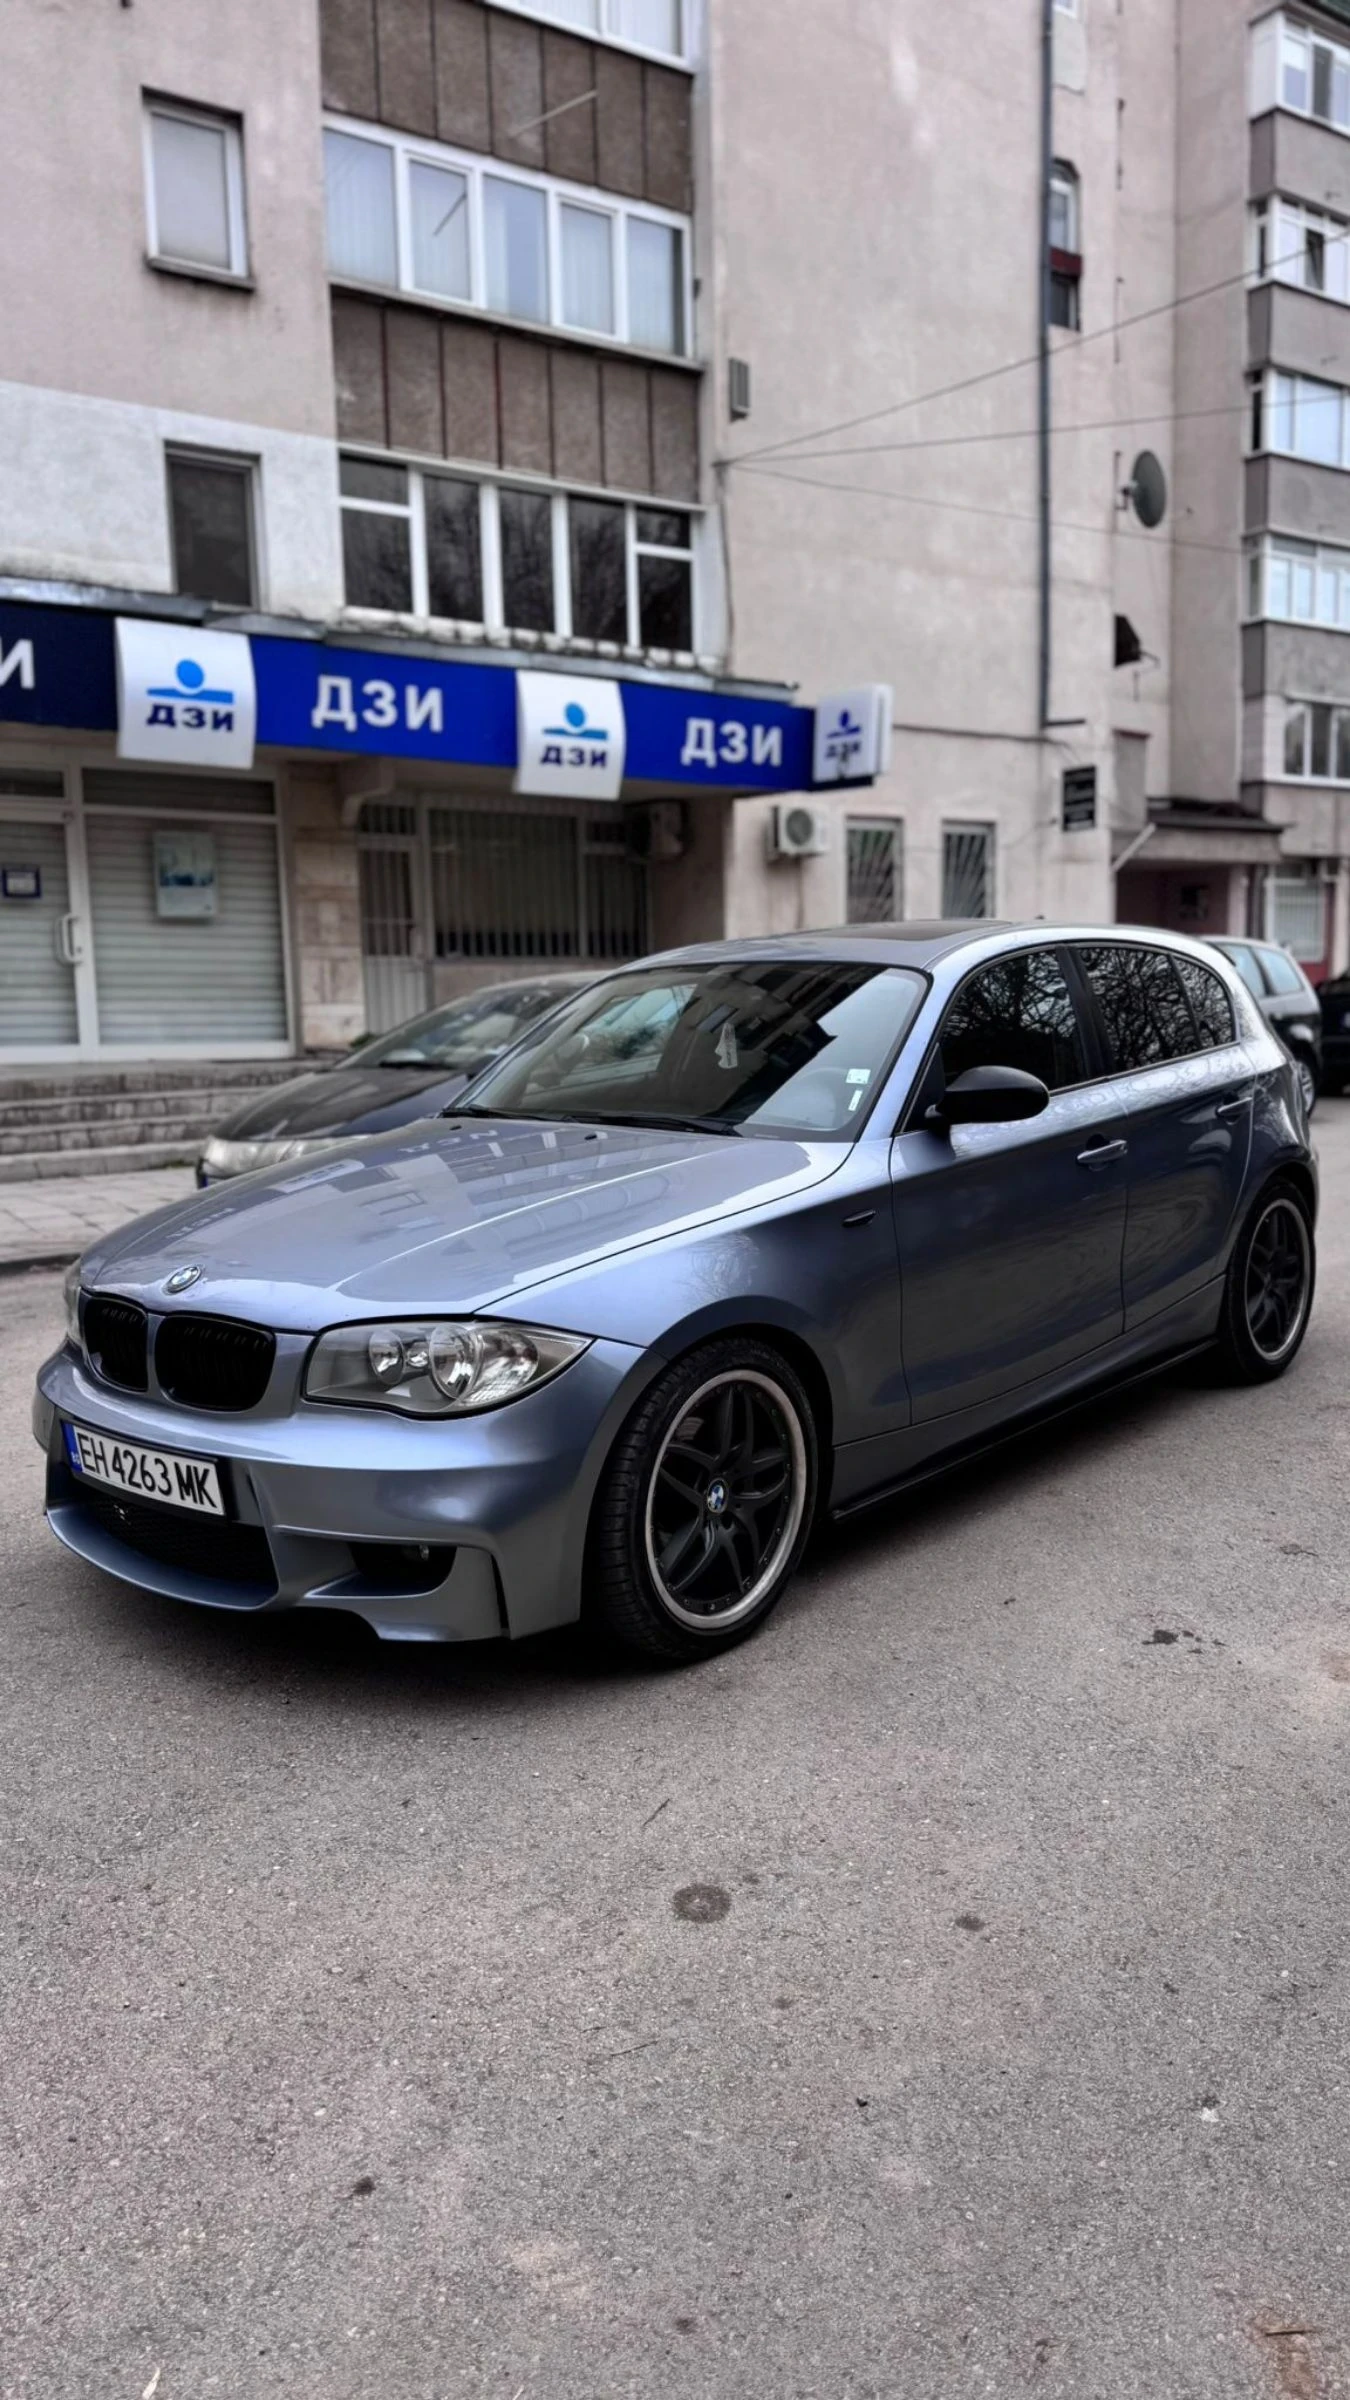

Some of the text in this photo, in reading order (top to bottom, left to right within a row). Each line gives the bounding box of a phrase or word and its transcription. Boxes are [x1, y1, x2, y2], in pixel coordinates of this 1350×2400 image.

[146, 703, 235, 732] ДЗИ
[311, 674, 443, 733] ДЗИ
[539, 745, 608, 768] ДЗИ
[680, 717, 782, 767] ДЗИ
[76, 1432, 218, 1509] EH 4263 MK
